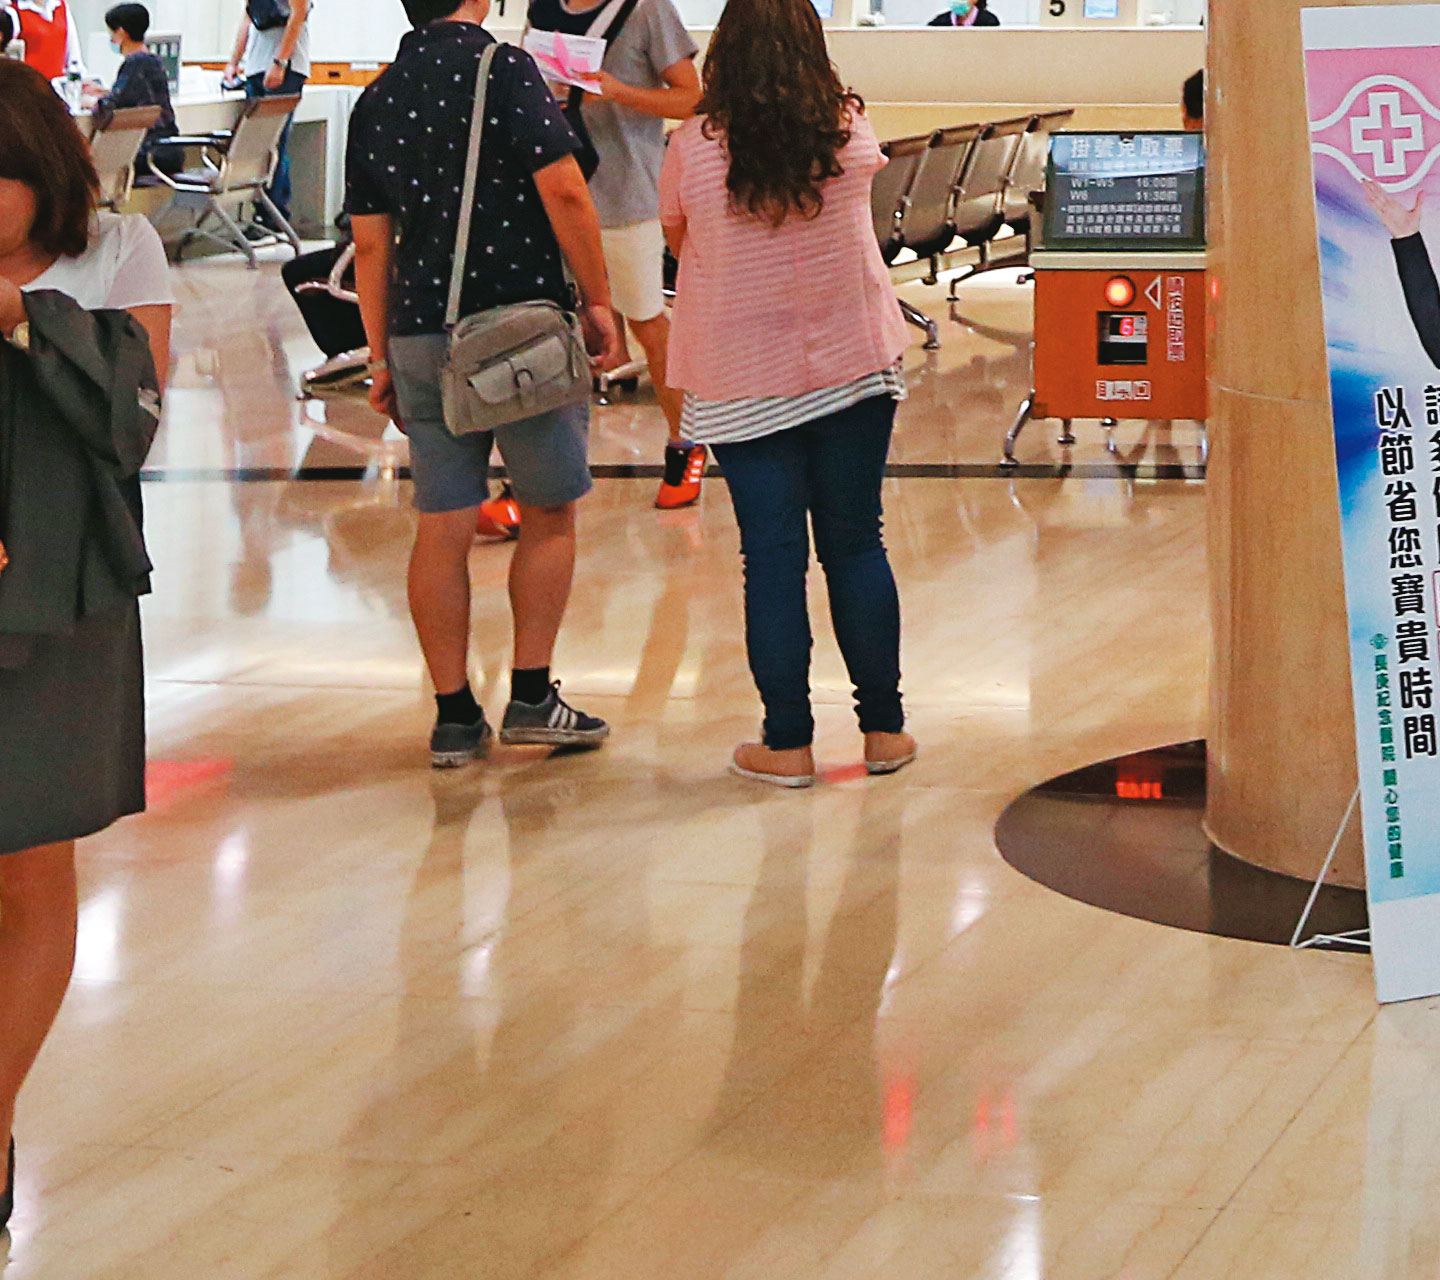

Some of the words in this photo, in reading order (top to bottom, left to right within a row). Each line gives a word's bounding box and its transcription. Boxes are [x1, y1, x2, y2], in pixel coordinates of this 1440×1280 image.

[1375, 386, 1437, 759] 以節省您寶貴時間
